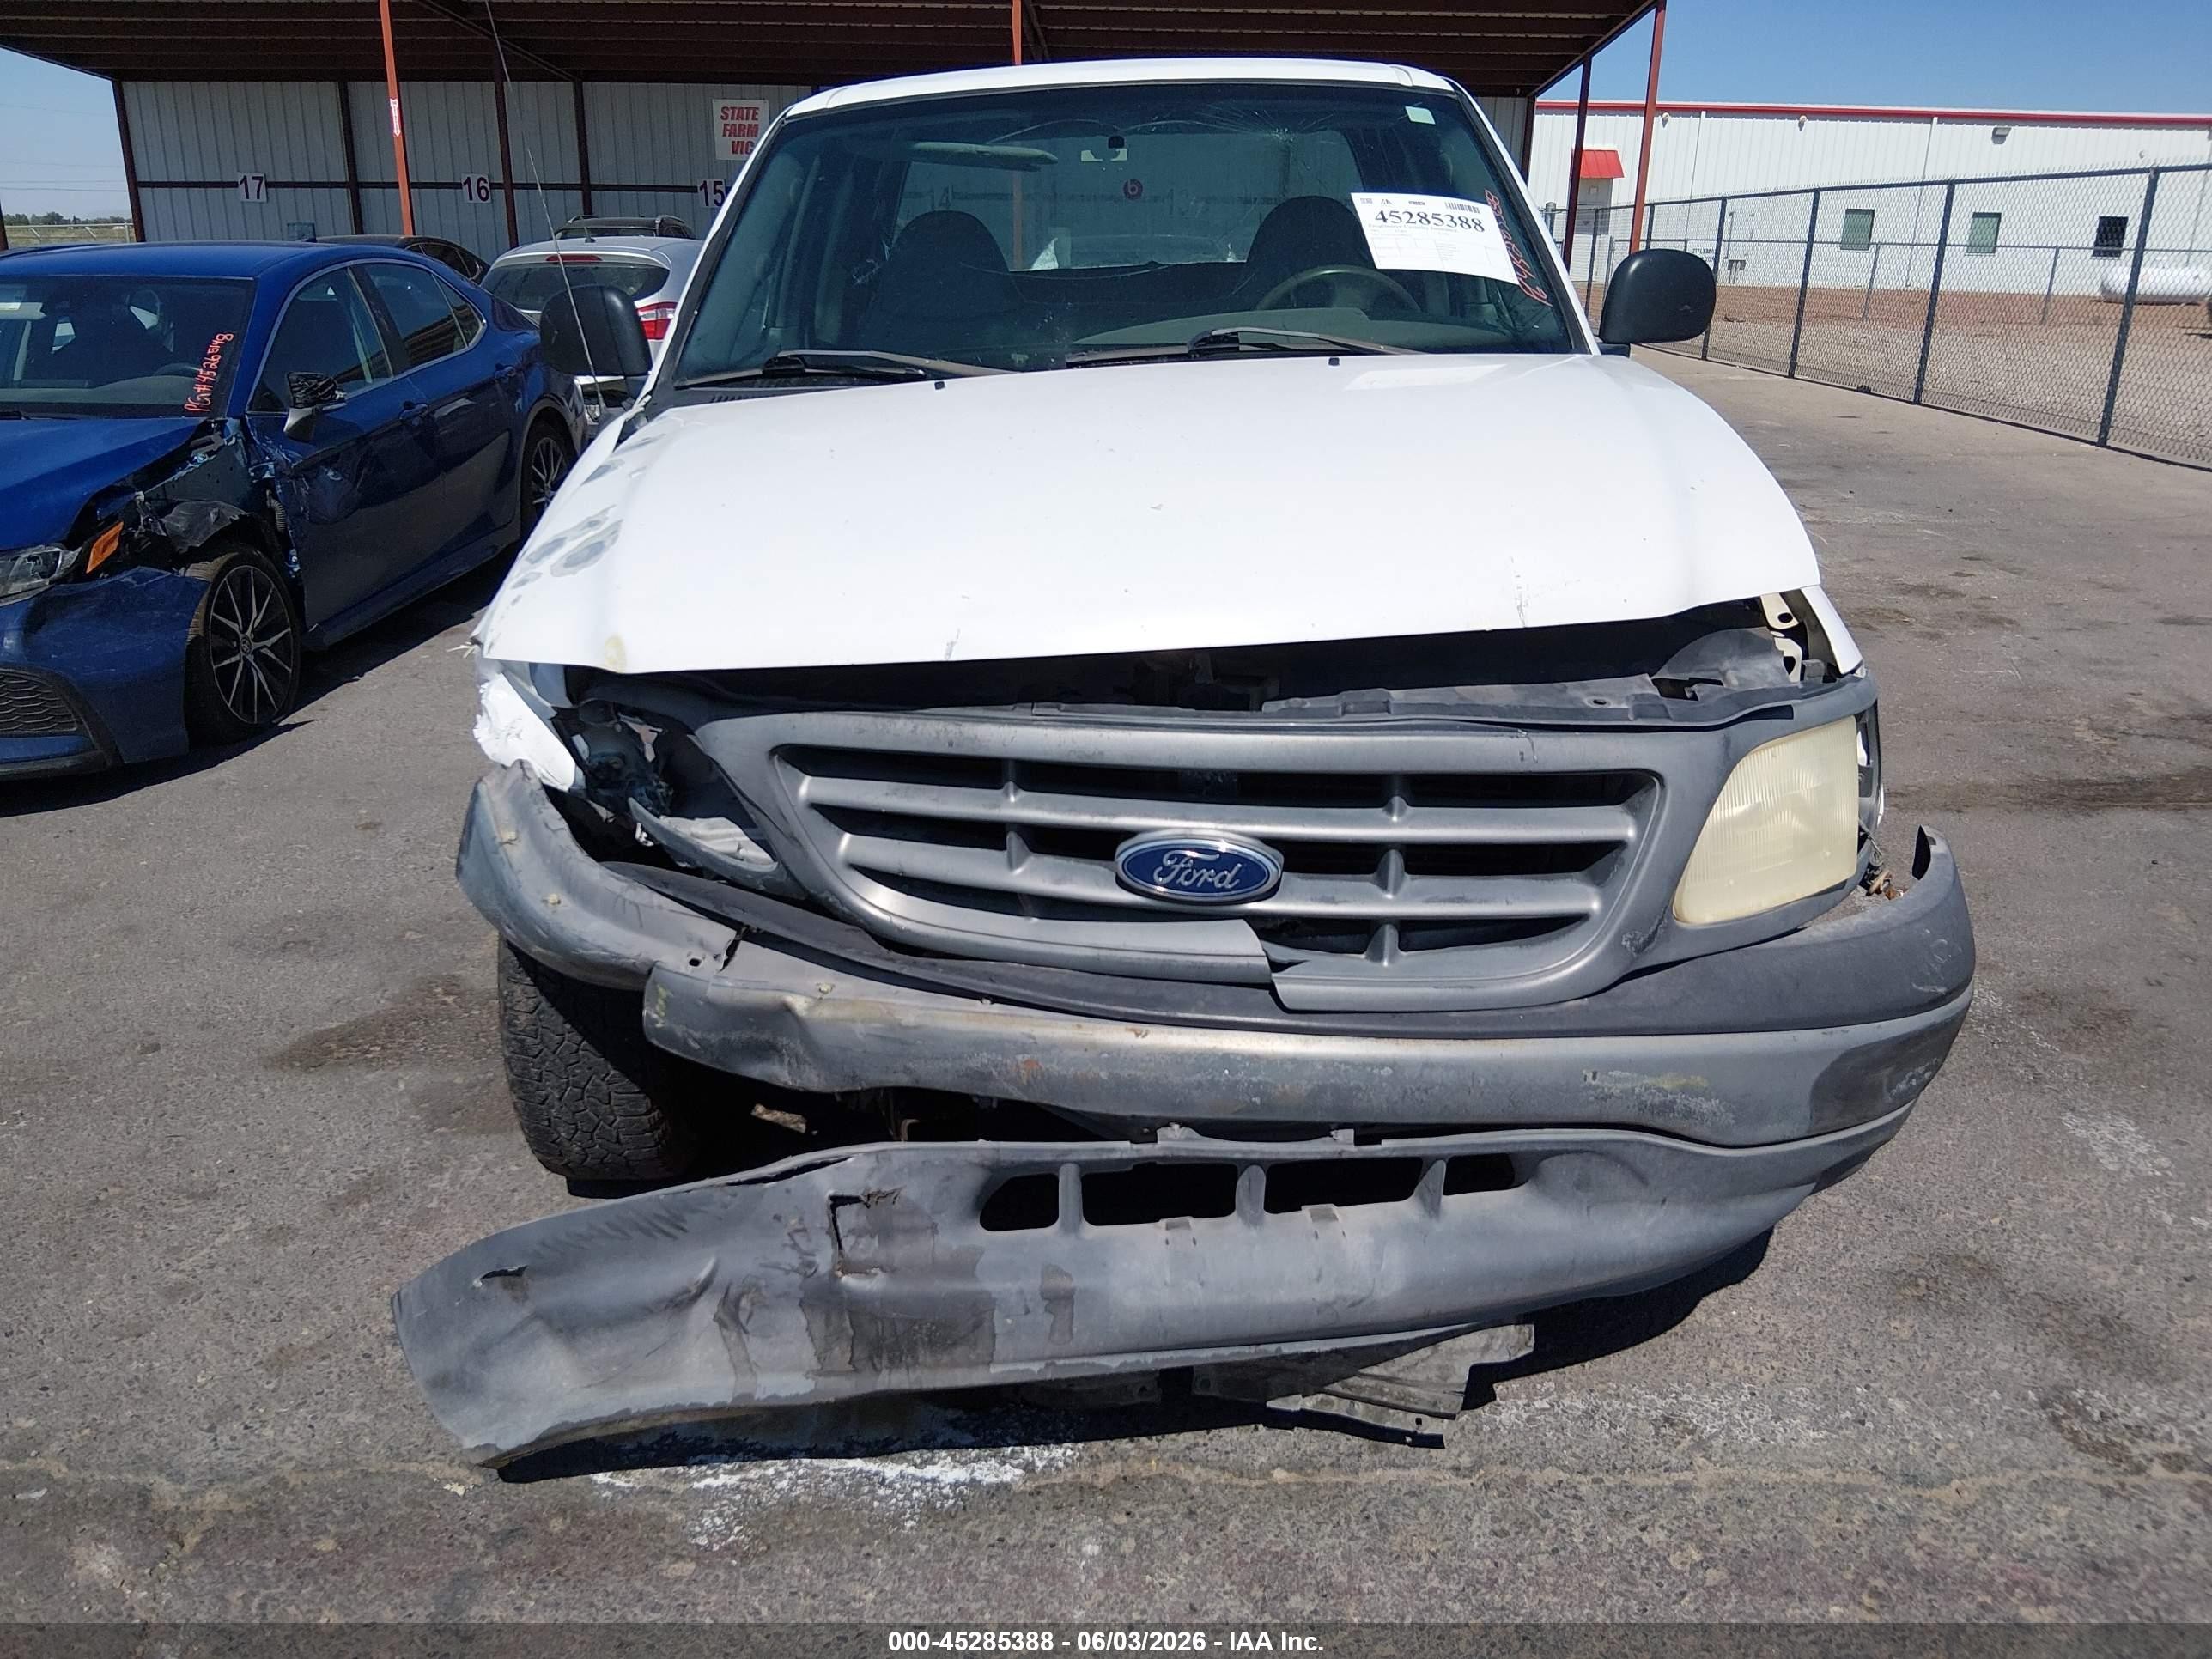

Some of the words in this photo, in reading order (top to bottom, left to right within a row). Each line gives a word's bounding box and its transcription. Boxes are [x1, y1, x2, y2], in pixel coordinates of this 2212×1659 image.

[720, 106, 759, 121] STATE
[722, 123, 759, 137] FARM
[732, 140, 755, 155] VIC
[239, 174, 264, 200] 17
[461, 176, 490, 202] 16
[699, 179, 726, 206] 15
[1375, 210, 1486, 233] 45285388
[1152, 849, 1243, 889] Ford
